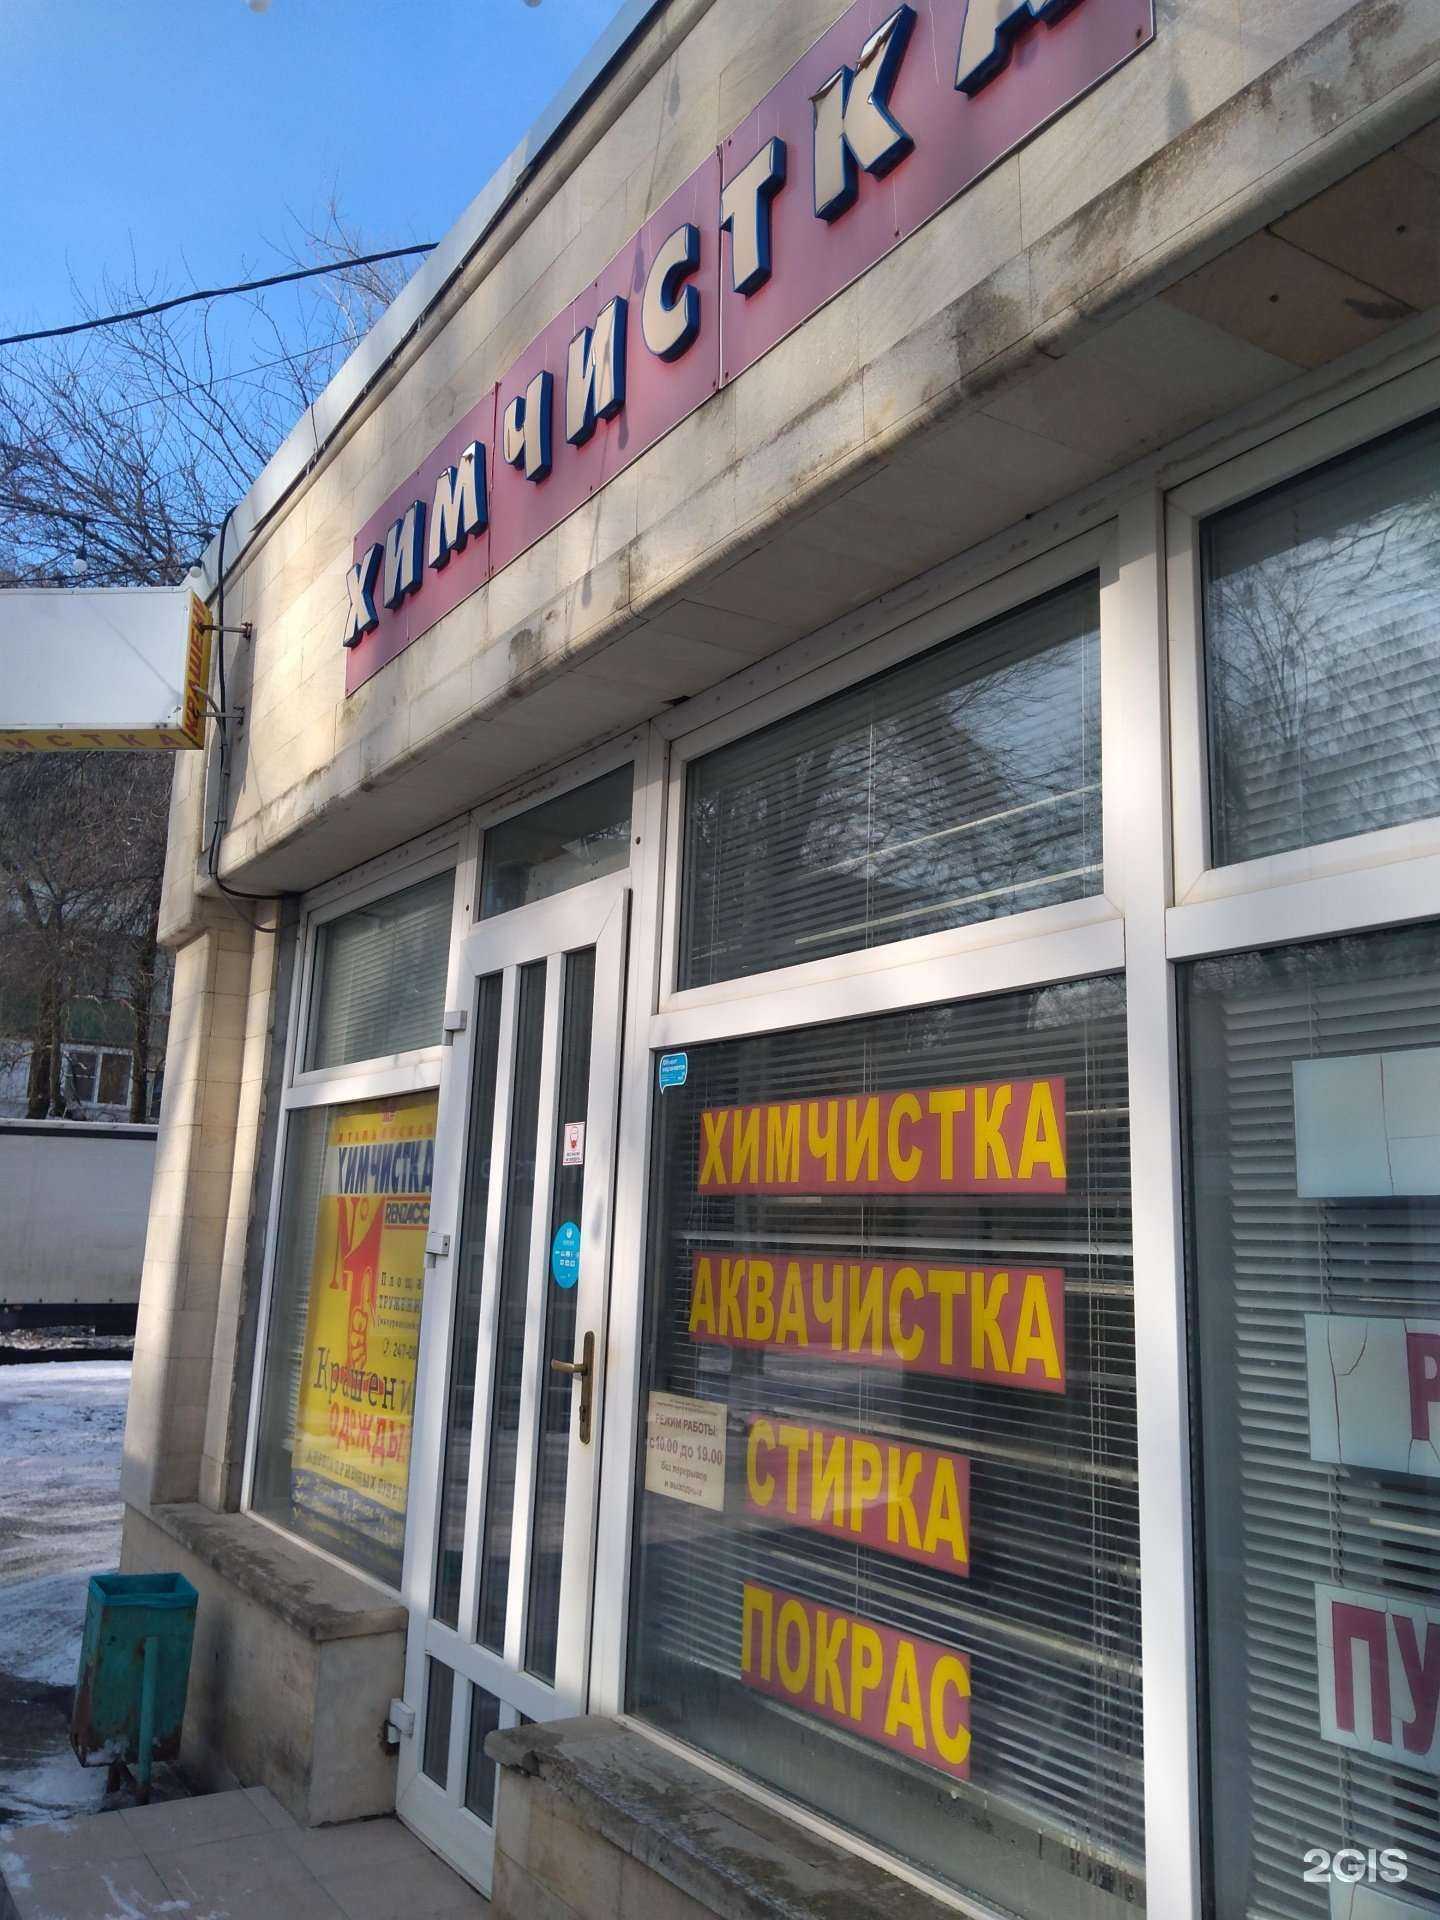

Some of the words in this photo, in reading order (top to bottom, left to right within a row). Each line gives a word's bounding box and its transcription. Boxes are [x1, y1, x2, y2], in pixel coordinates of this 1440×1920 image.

[699, 1081, 1066, 1185] ХИМЧИСТКА
[688, 1257, 1061, 1380] АКВАЧИСТКА
[656, 1413, 681, 1429] РЕЖИМ
[680, 1444, 693, 1459] до
[697, 1445, 723, 1466] 19.00
[746, 1418, 968, 1563] СТИРКА
[741, 1586, 972, 1765] ПОКРАС
[1331, 1601, 1440, 1755] ПУ
